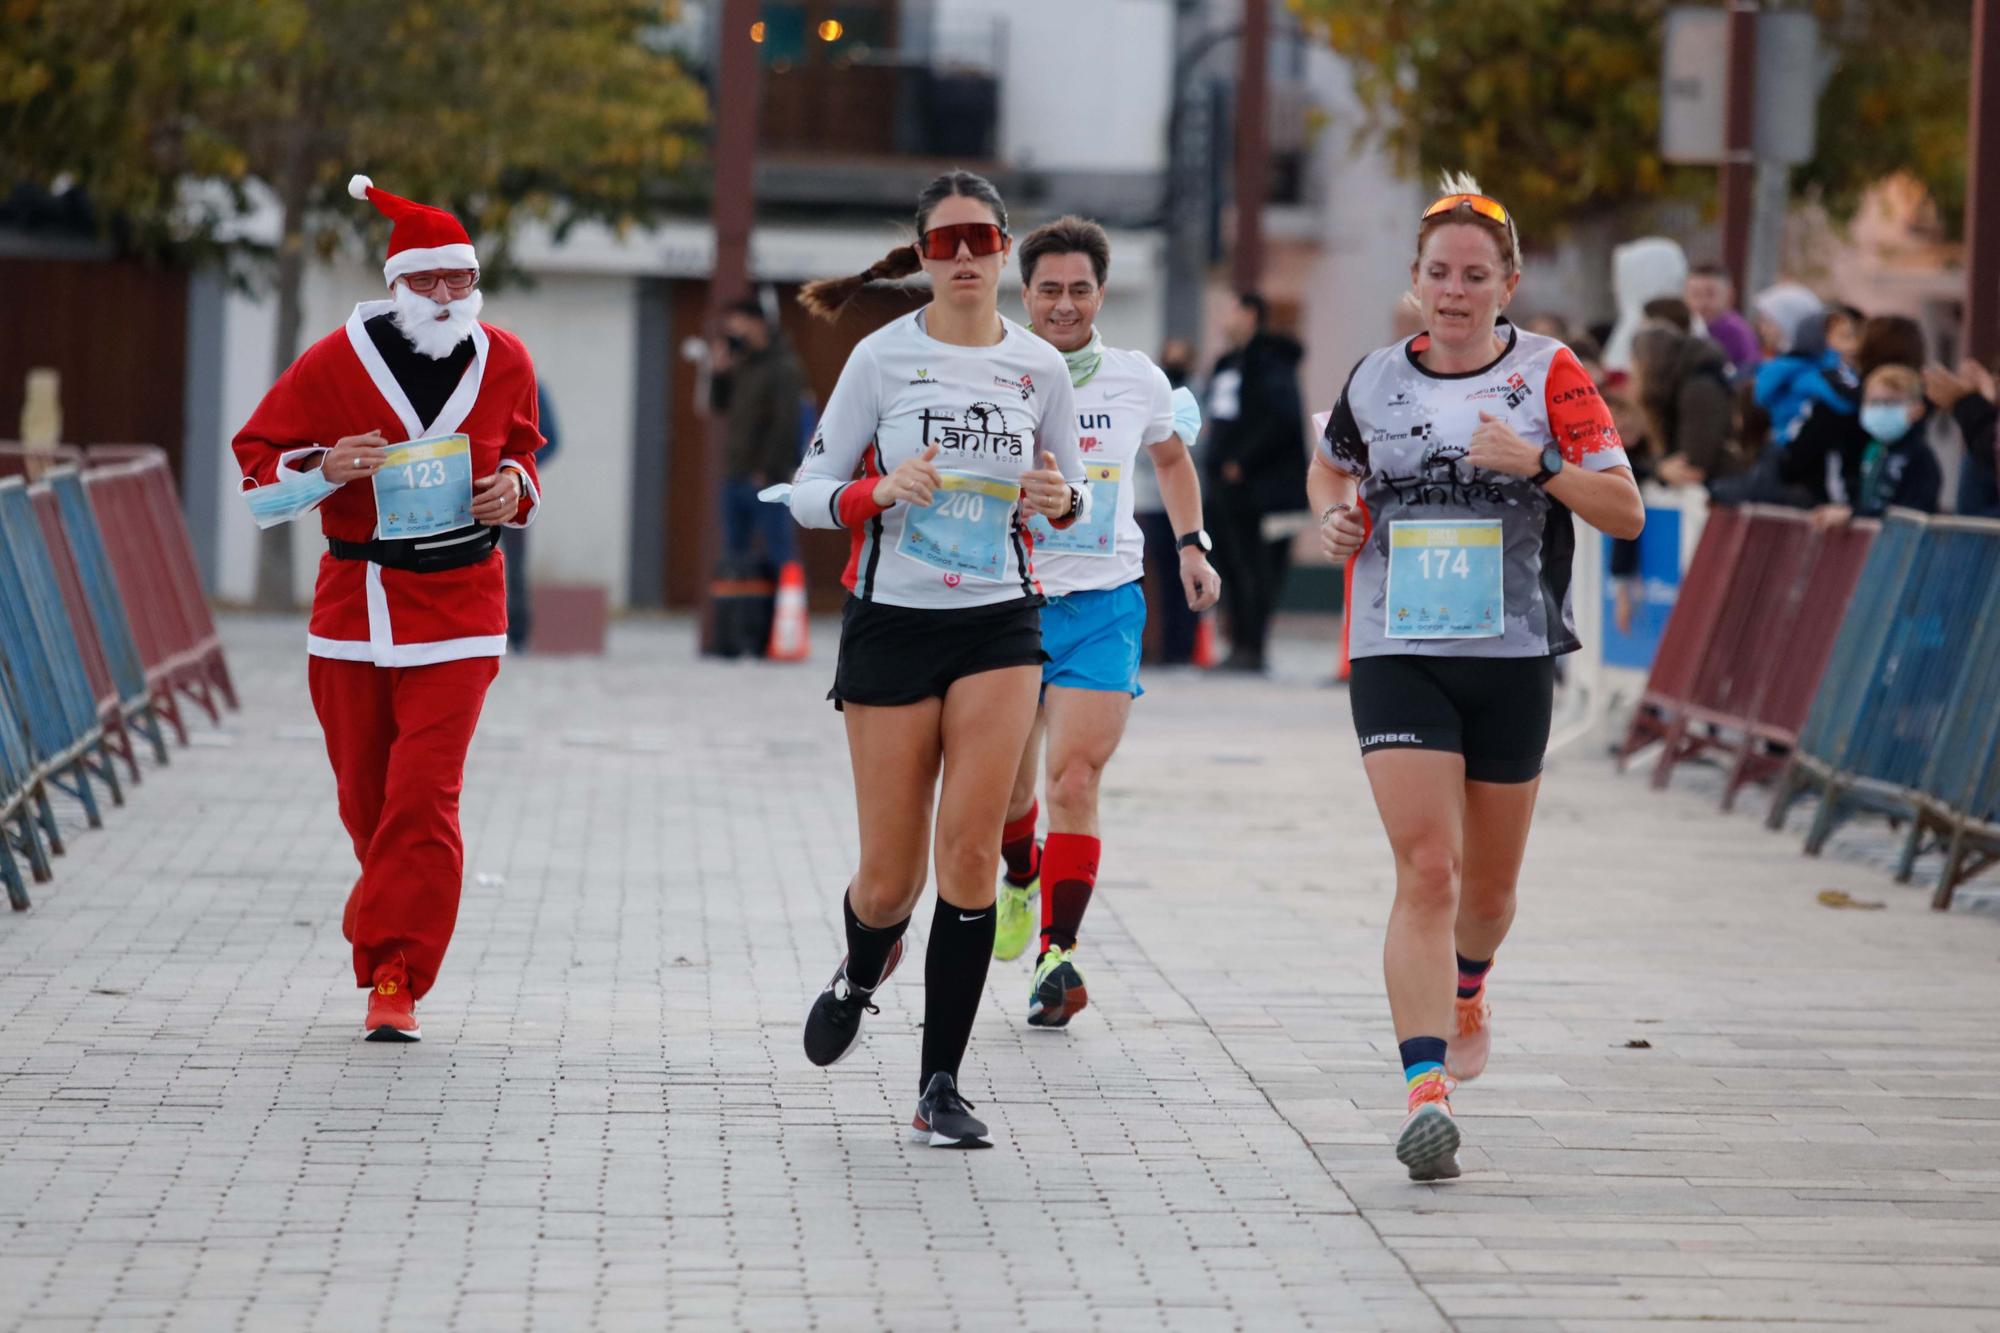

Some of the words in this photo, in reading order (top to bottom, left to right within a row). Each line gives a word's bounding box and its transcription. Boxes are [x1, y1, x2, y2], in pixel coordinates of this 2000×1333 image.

[403, 459, 446, 489] 123
[936, 491, 984, 523] 200
[1418, 548, 1470, 580] 174
[1360, 733, 1423, 747] LURBEL
